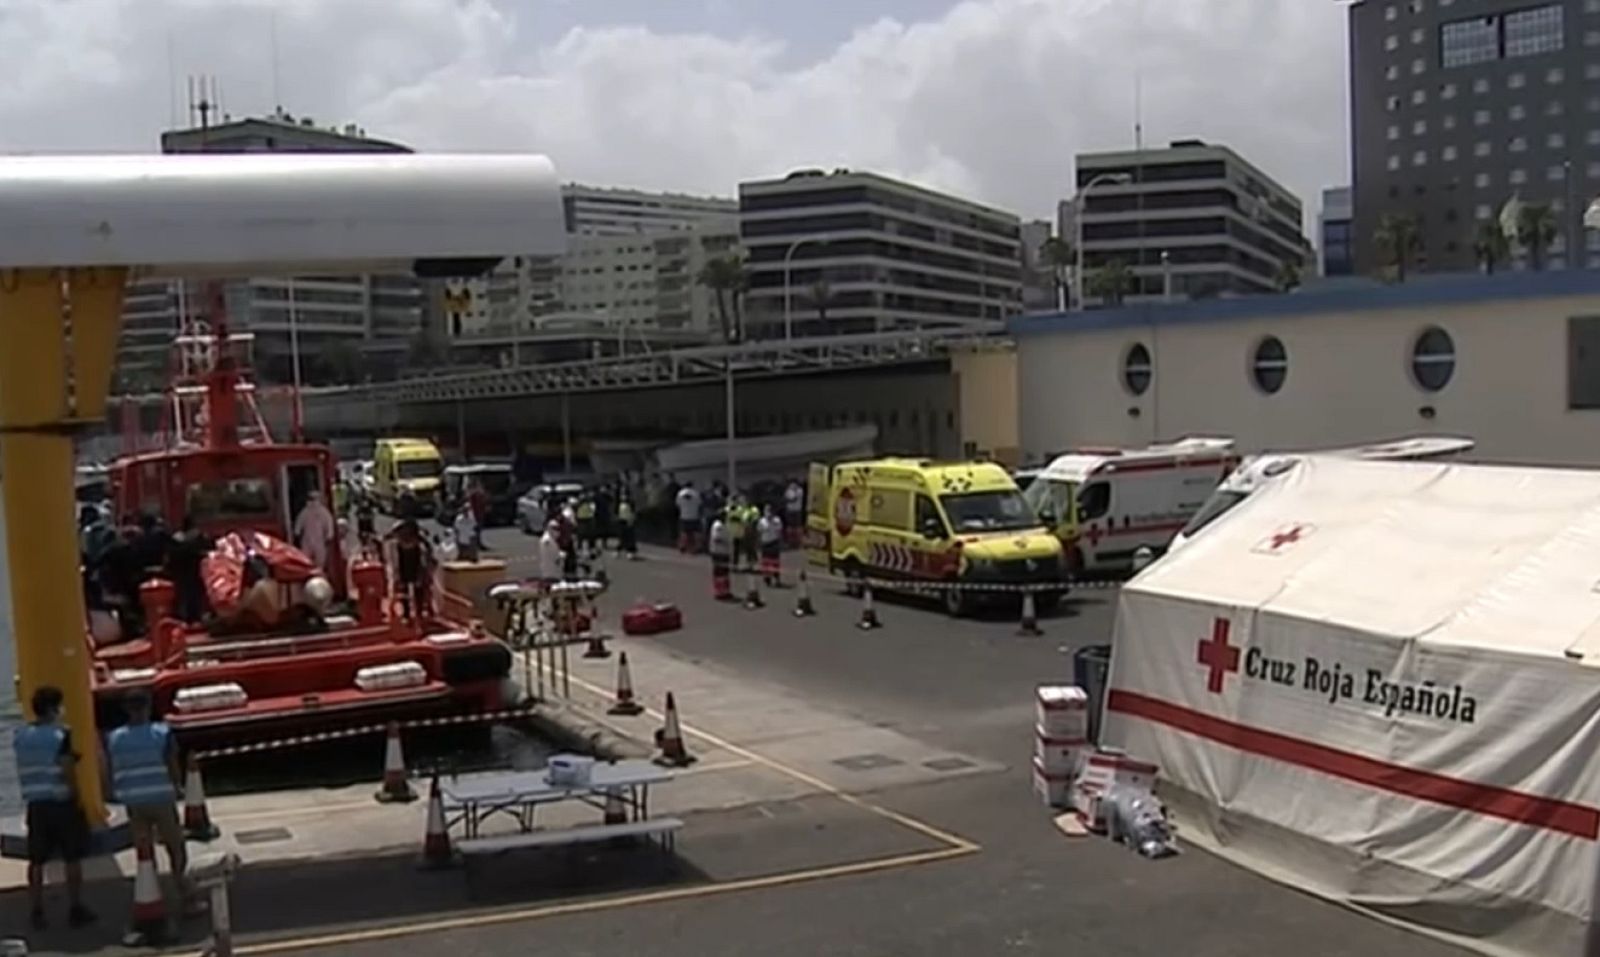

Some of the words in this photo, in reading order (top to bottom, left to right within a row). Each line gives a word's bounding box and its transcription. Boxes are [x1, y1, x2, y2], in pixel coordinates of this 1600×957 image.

[1245, 648, 1296, 685] Cruz
[1304, 658, 1353, 704] Roja
[1363, 669, 1476, 723] Española
